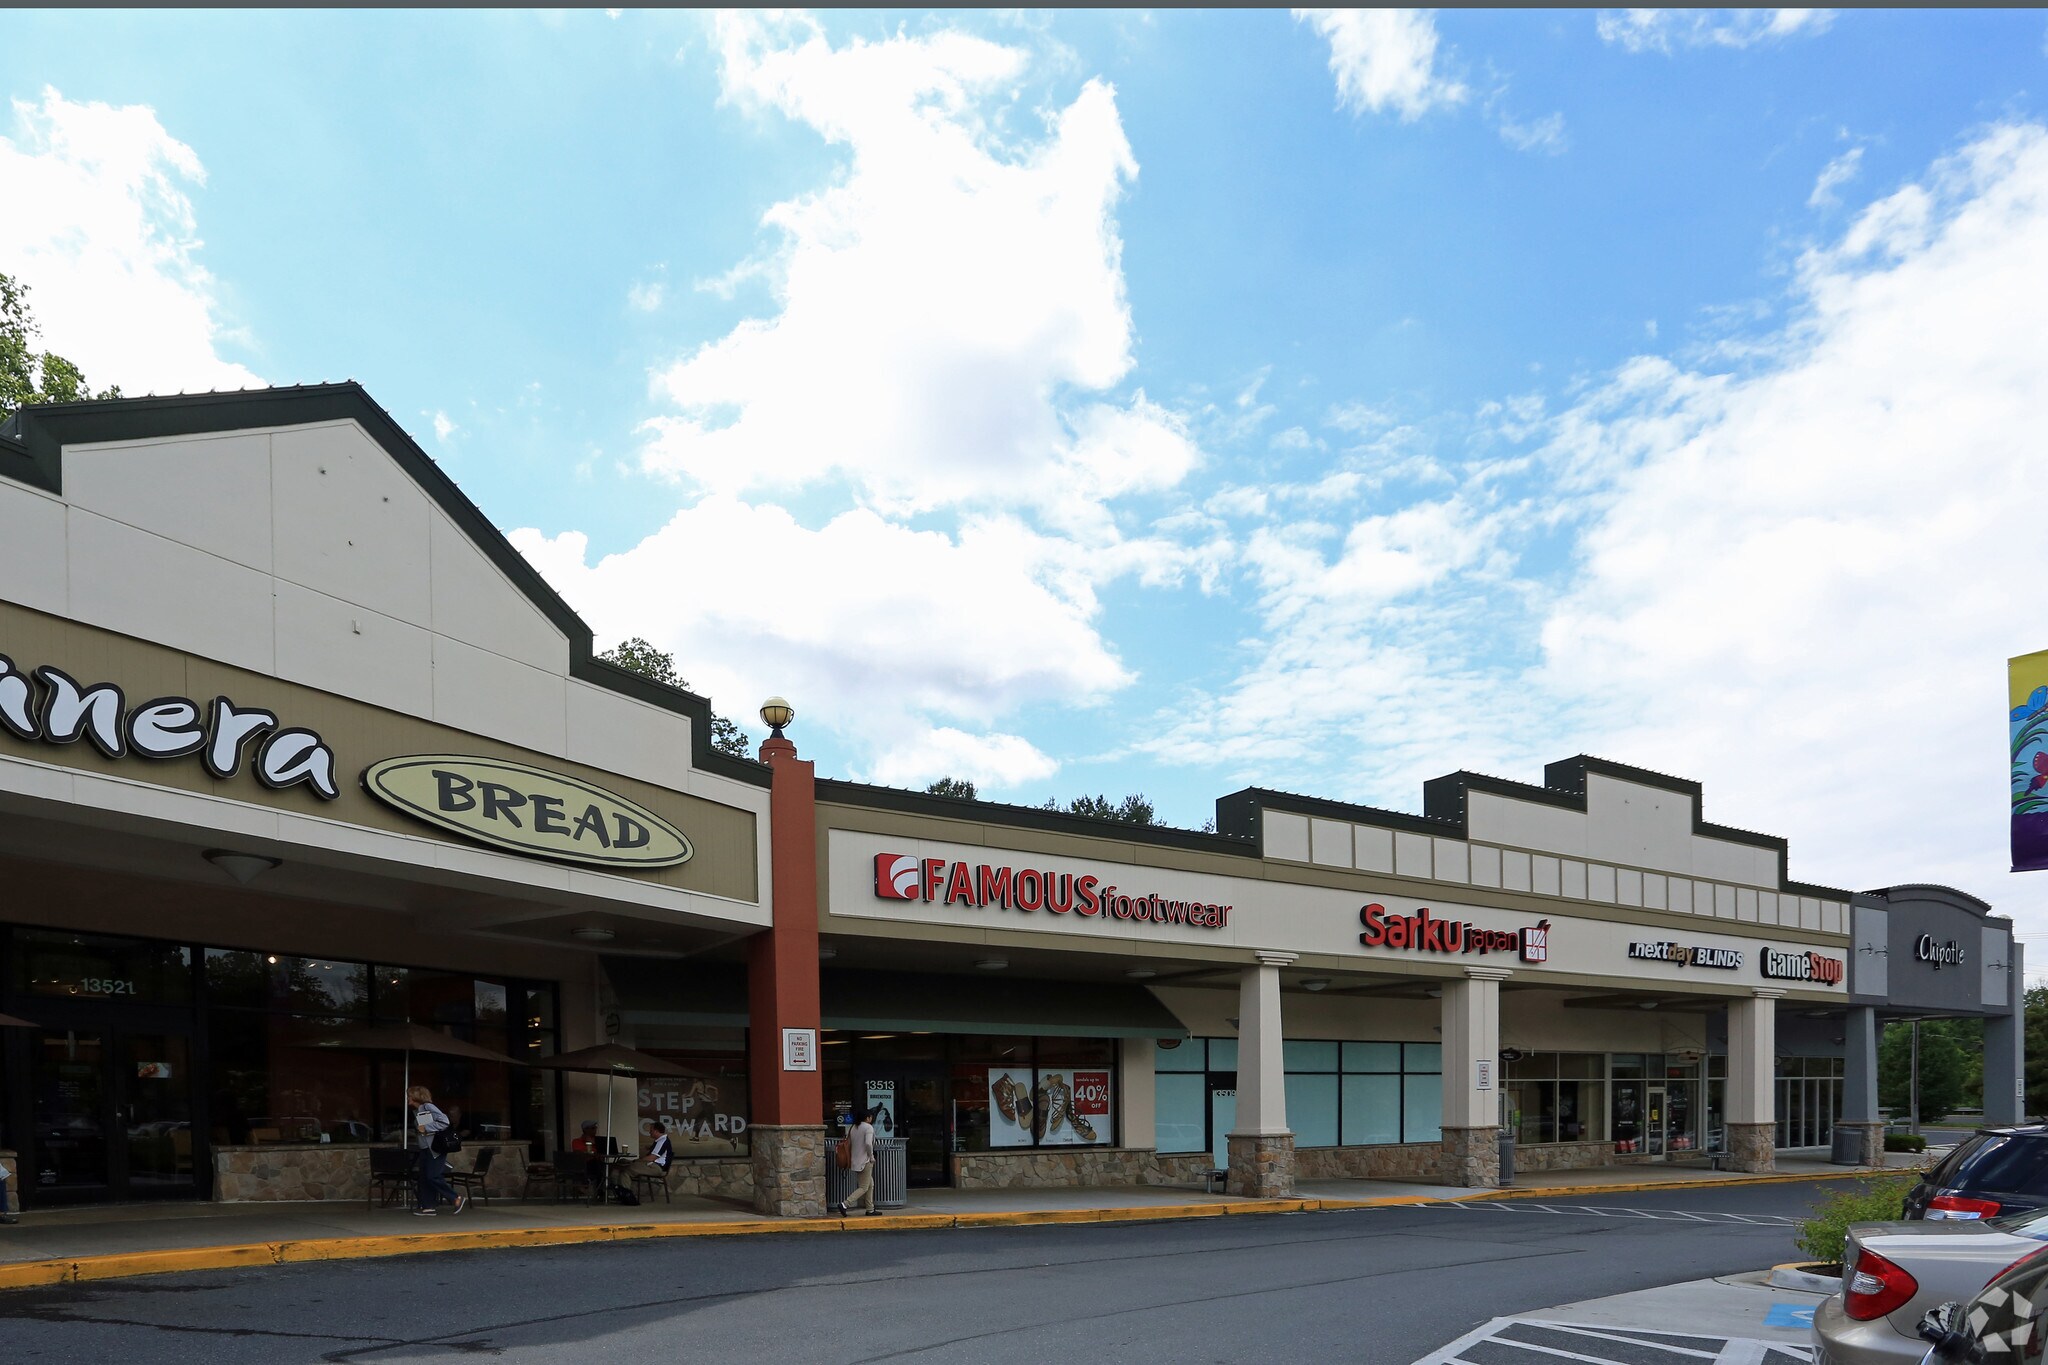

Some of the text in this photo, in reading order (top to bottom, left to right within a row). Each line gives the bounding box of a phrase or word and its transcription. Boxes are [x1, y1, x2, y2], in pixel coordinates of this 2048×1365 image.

[432, 769, 651, 849] BREAD
[922, 858, 1232, 928] FAMOUS footwear
[1360, 903, 1518, 954] Sarku japan
[1696, 948, 1744, 968] BLINDS
[1762, 947, 1843, 985] GameStop
[1918, 934, 1964, 970] Chipotle
[81, 977, 137, 995] 13521
[865, 1080, 895, 1090] 13513
[1075, 1085, 1108, 1102] 40%
[639, 1088, 695, 1114] STEP
